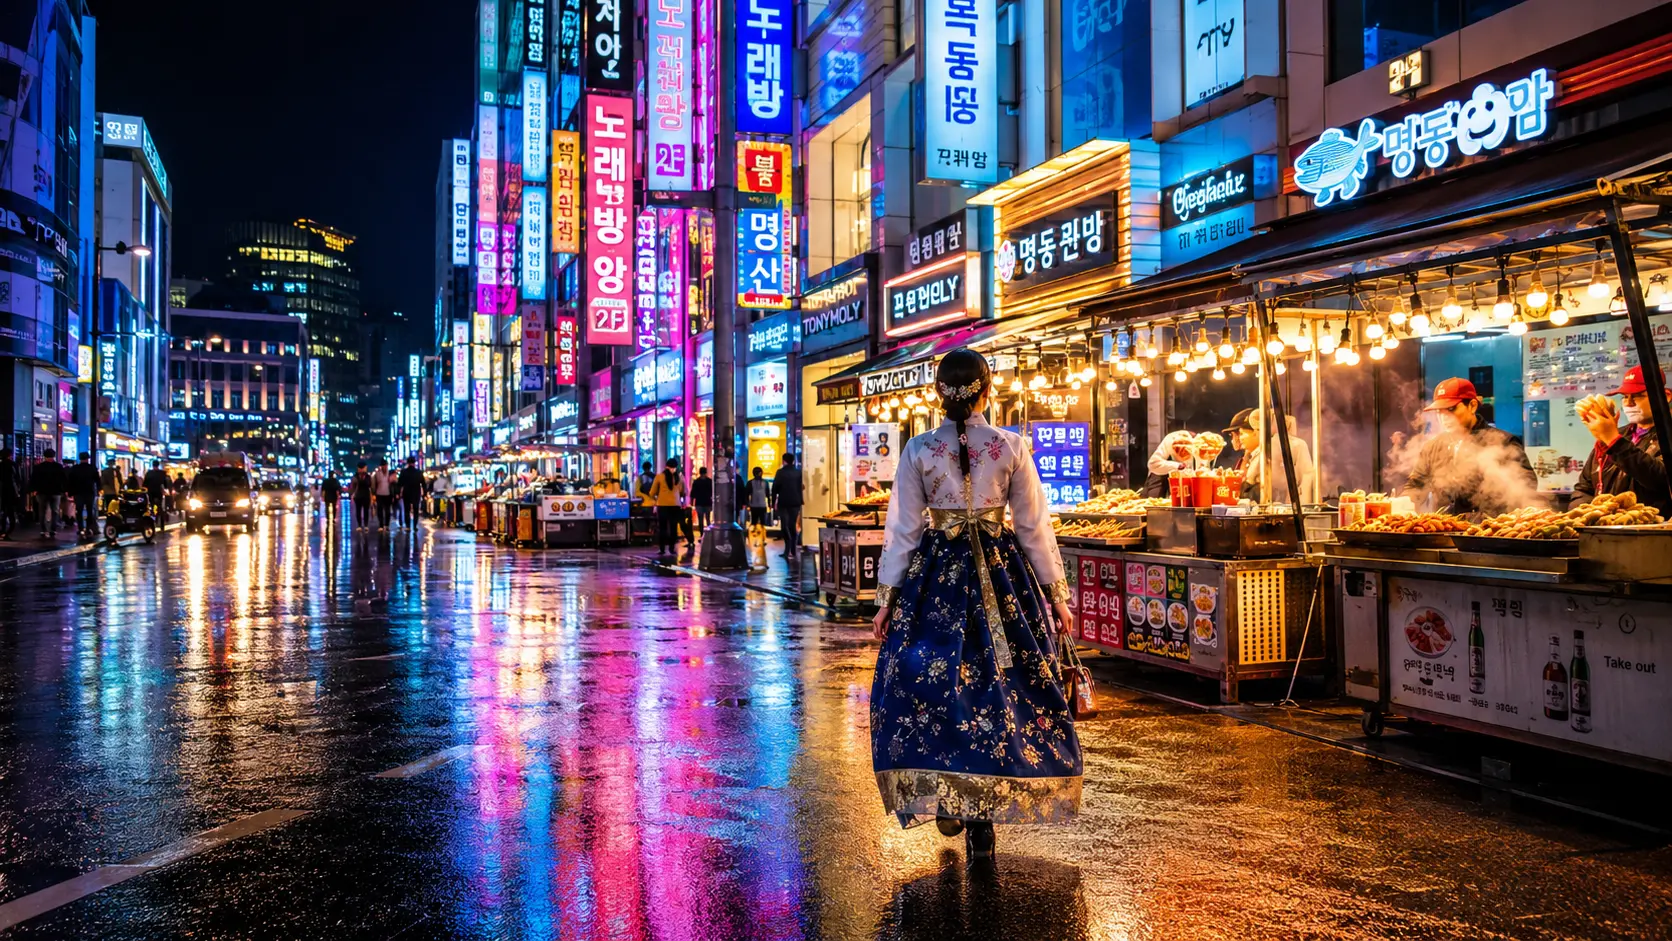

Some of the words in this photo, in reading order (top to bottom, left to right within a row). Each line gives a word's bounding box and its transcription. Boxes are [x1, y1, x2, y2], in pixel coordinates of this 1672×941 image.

[595, 308, 624, 331] 2F
[803, 301, 861, 335] TONYMOLY
[1604, 655, 1632, 670] Take
[1635, 662, 1656, 674] out
